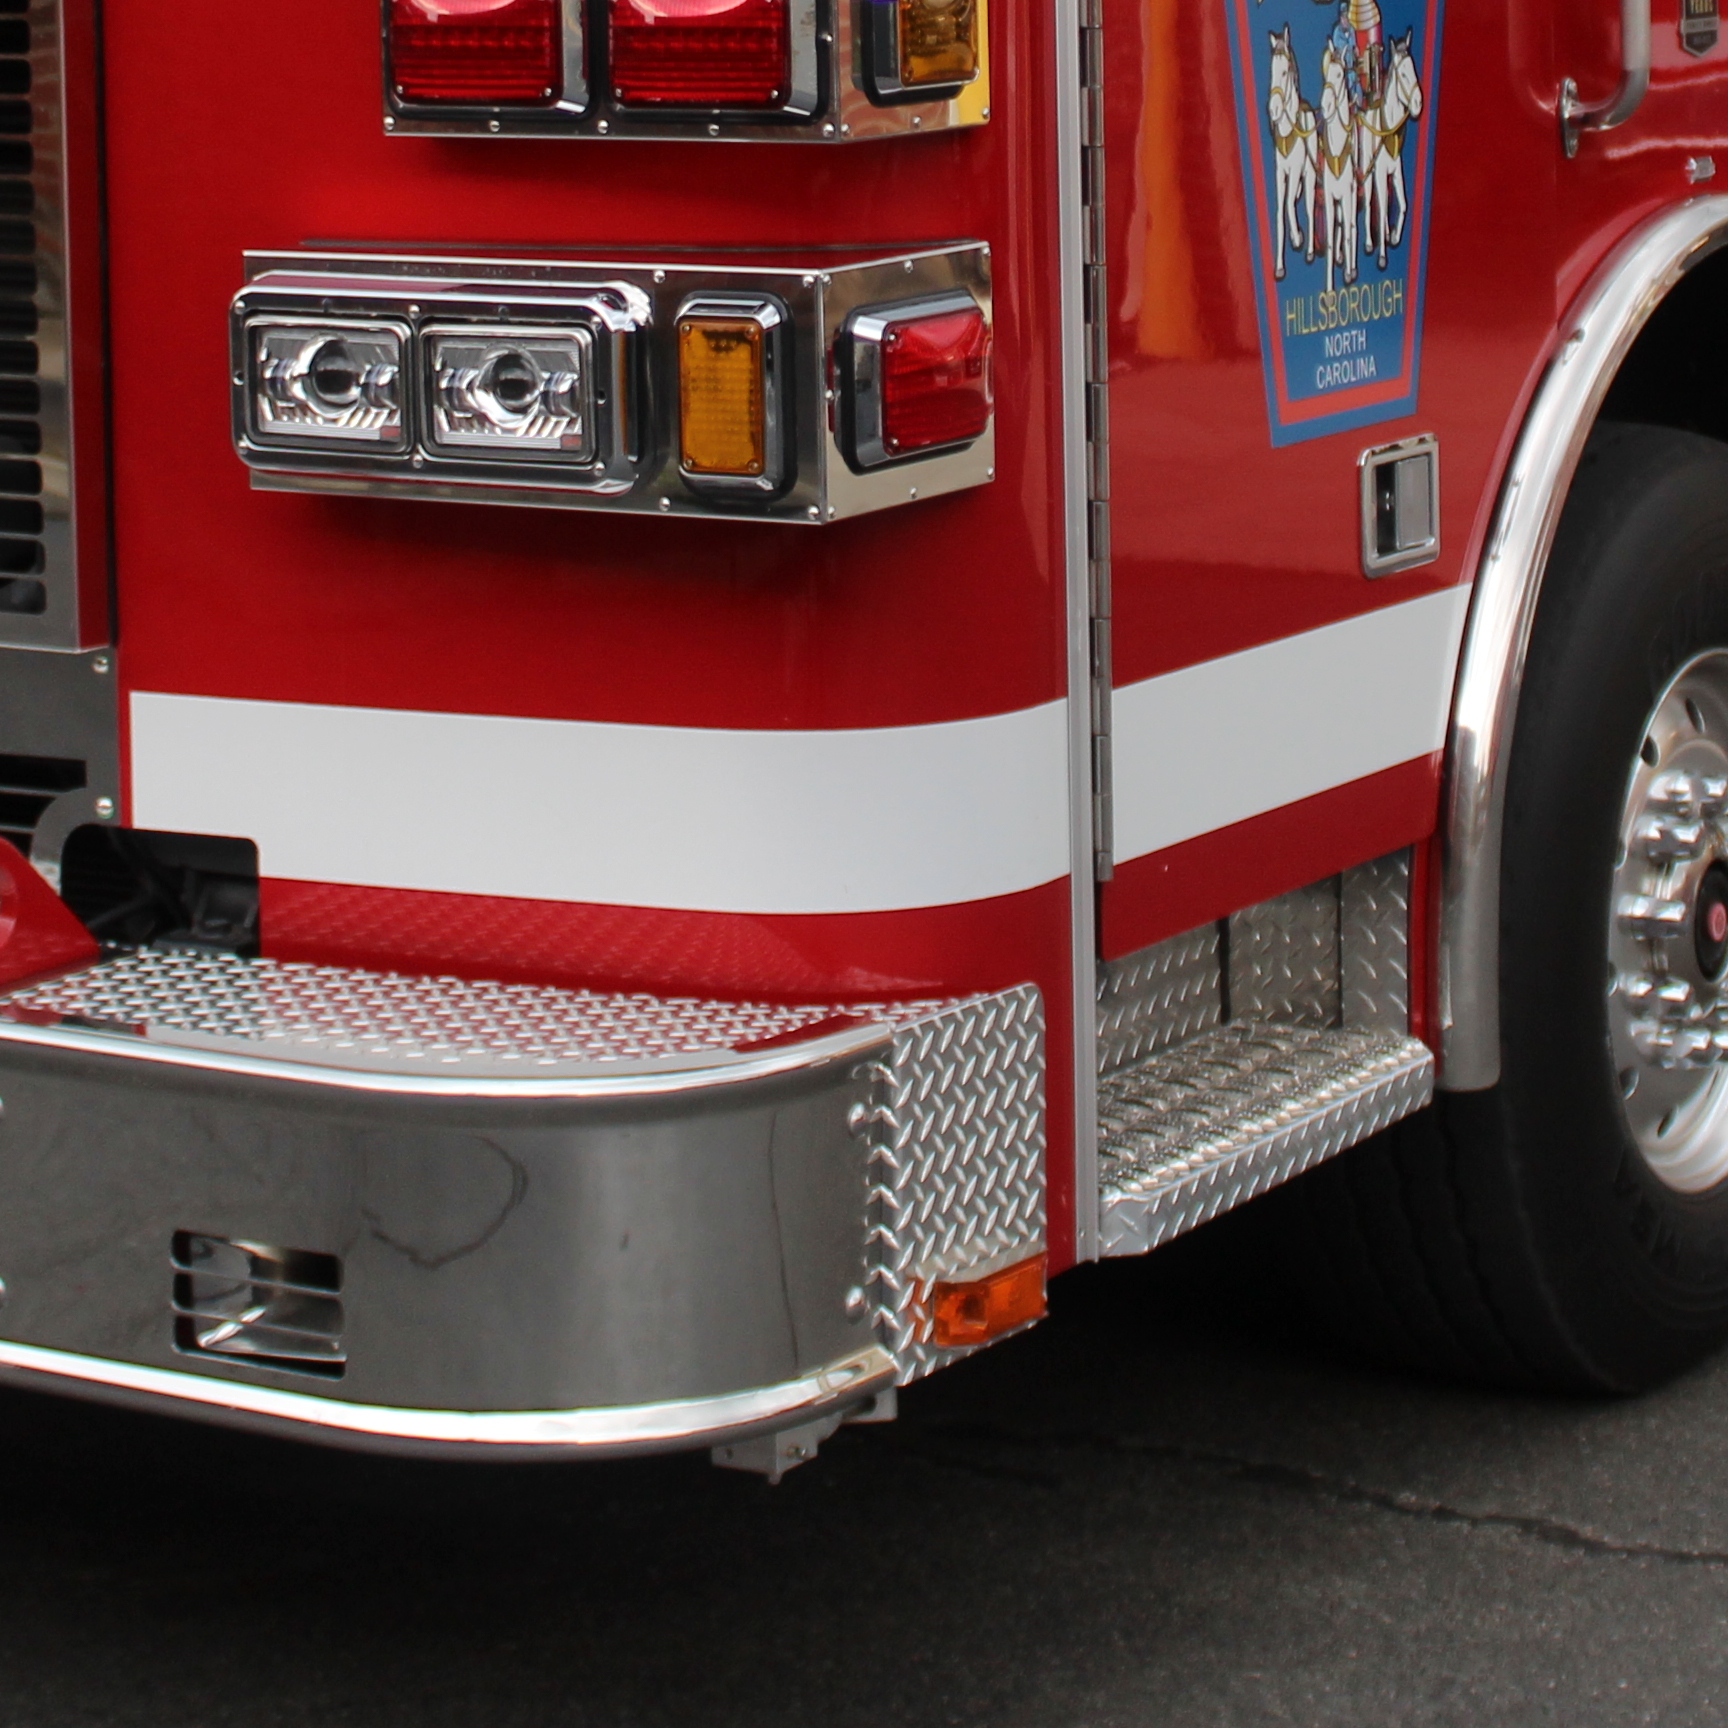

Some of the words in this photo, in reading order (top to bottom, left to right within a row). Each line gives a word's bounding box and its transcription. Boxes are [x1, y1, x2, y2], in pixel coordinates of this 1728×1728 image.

[1286, 278, 1403, 337] HILLSBOROUGH
[1325, 328, 1367, 358] NORTH
[1316, 355, 1377, 389] CAROLINA
